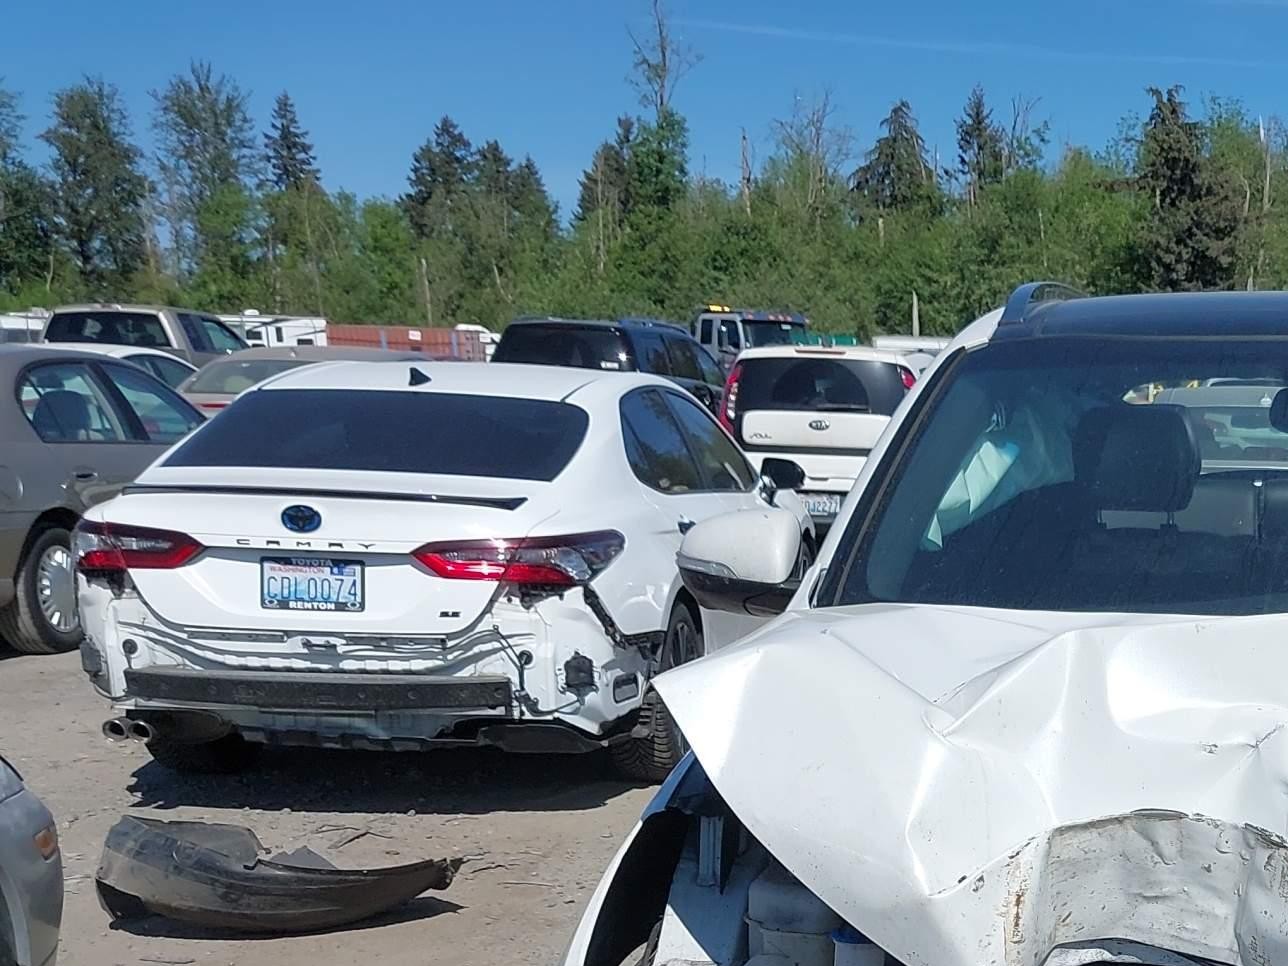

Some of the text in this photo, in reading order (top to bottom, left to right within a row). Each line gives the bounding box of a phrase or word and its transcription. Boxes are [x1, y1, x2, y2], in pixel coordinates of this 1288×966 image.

[236, 539, 376, 549] CAMRY
[291, 558, 333, 567] TOYOTA
[270, 566, 325, 574] WASHINGTON
[267, 576, 357, 602] CDL0074
[289, 601, 335, 610] RENTON
